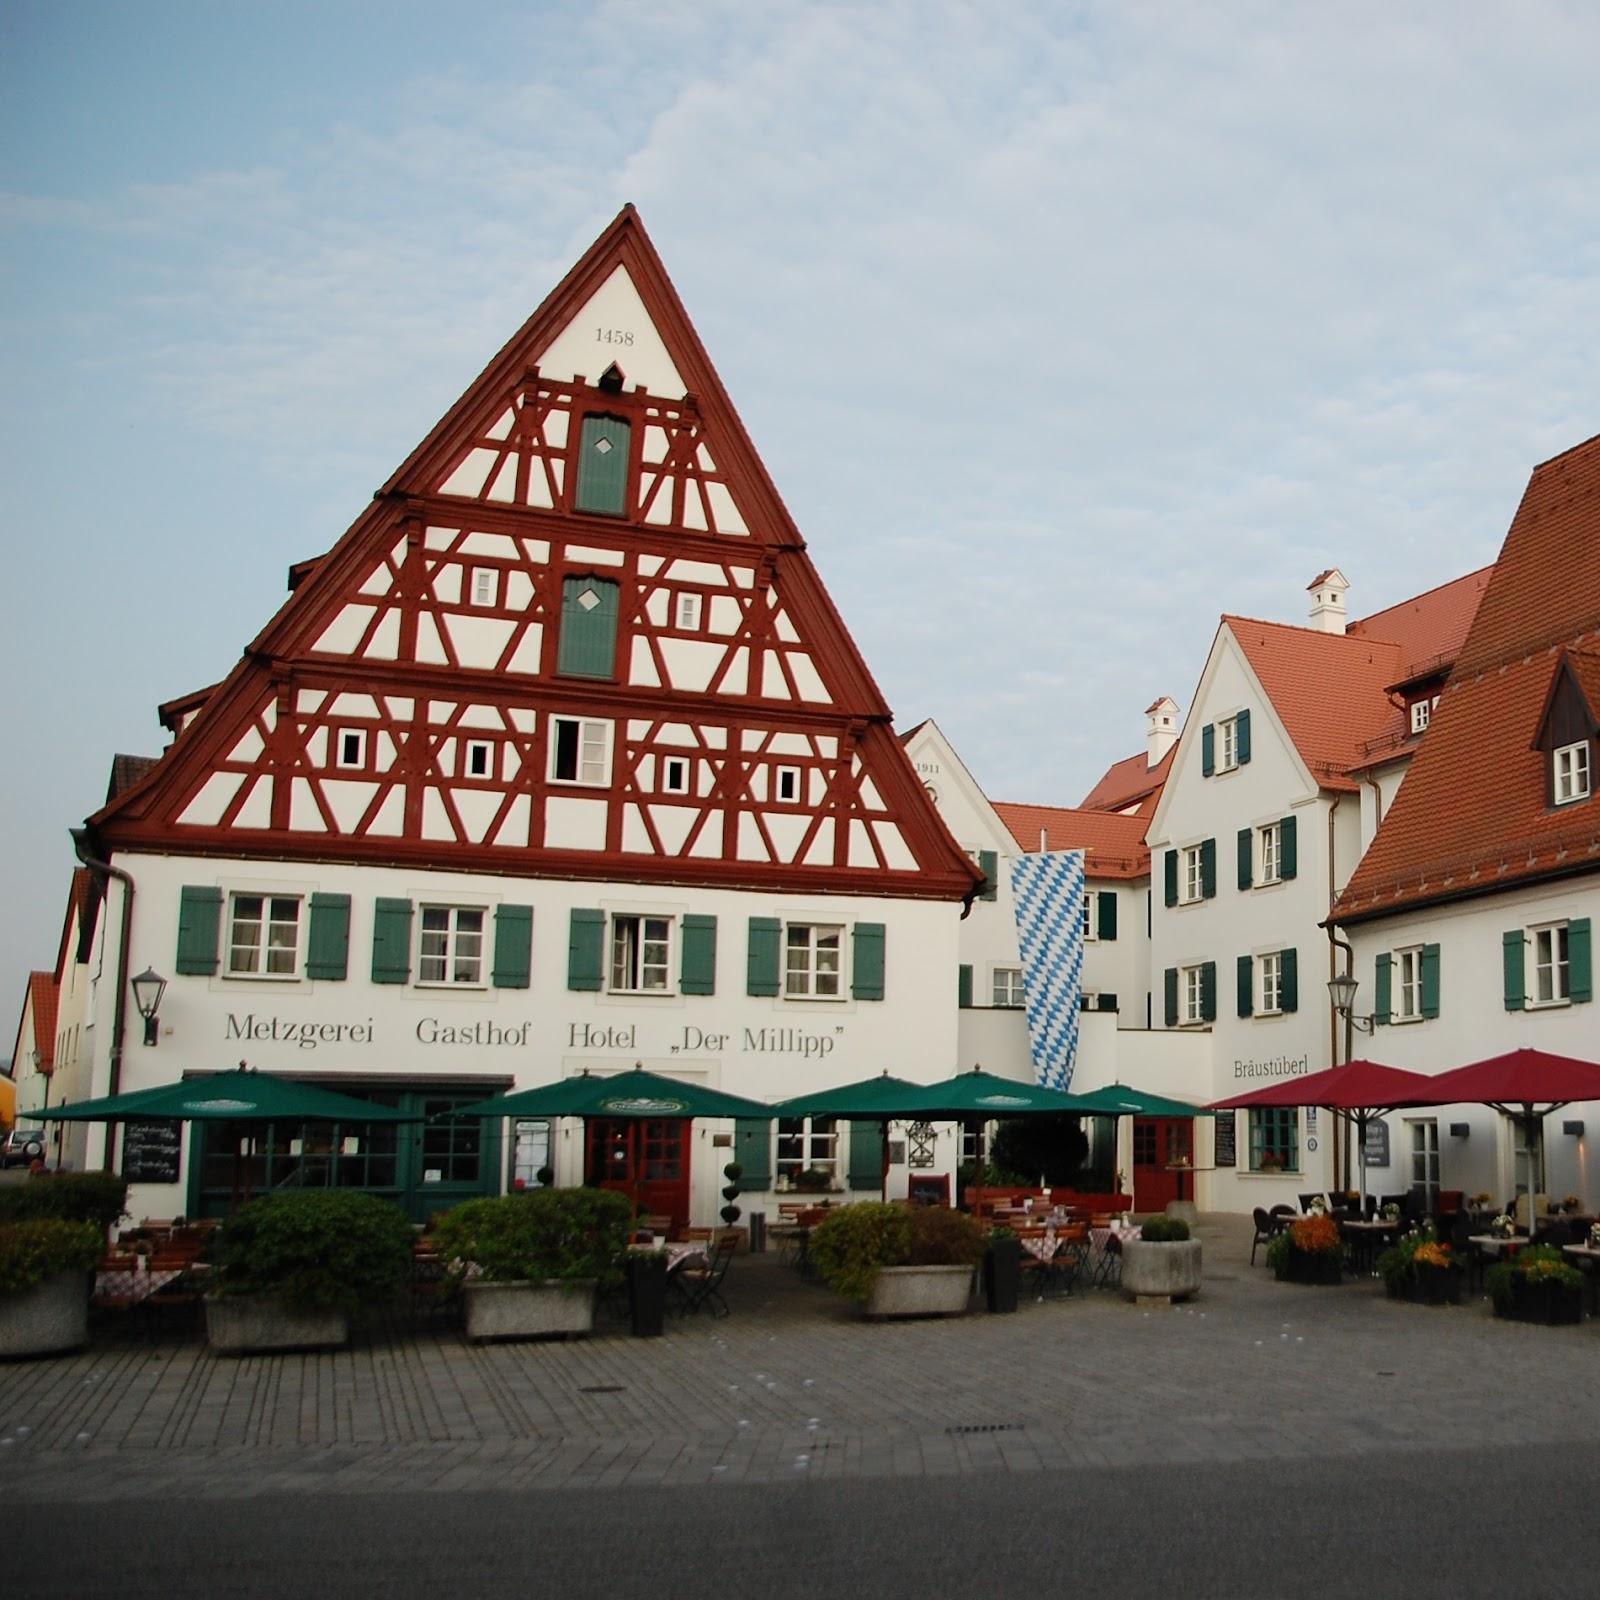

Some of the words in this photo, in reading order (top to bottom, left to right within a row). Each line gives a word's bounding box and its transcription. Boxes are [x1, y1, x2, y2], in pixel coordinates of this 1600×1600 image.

[596, 328, 634, 347] 1458
[917, 763, 939, 773] 1911
[224, 1013, 373, 1049] Metzgerei
[416, 1018, 532, 1046] Gasthof
[568, 1023, 637, 1049] Hotel
[1234, 1054, 1308, 1078] Bräustüberl
